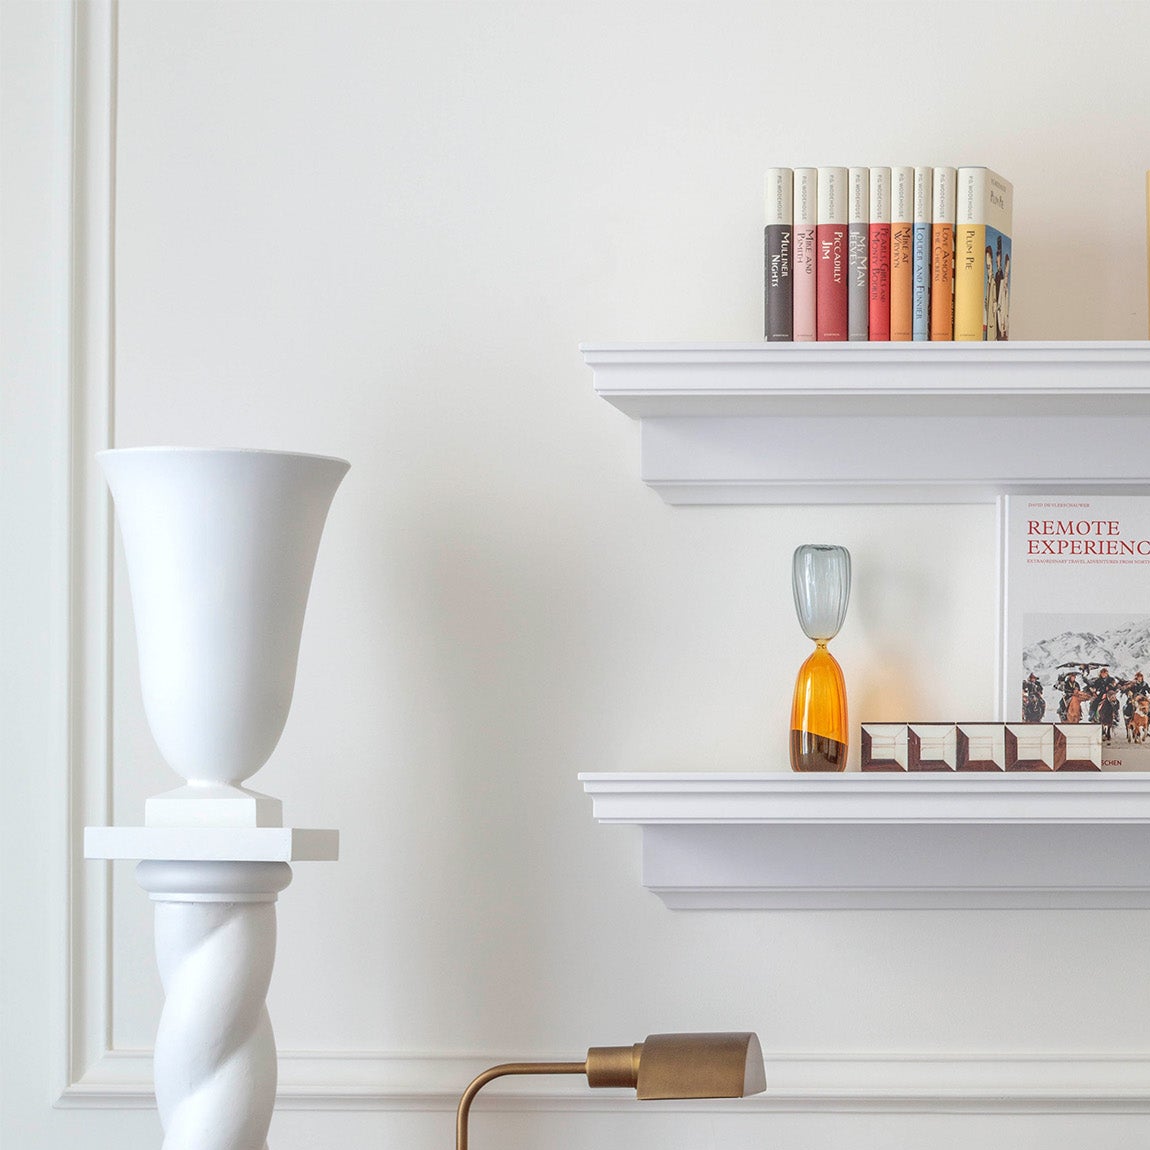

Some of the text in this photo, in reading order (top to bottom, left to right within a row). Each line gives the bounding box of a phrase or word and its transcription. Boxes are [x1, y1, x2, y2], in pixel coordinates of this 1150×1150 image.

[781, 232, 790, 277] MULLINER
[797, 233, 805, 263] PSMITH
[805, 230, 814, 252] MIKE
[822, 240, 833, 259] JIM
[834, 231, 843, 283] PICCADILLY
[849, 230, 859, 265] JEEVES
[872, 231, 880, 265] MONTY
[902, 227, 911, 263] MIKE AT
[942, 227, 950, 282] LOVE AMONG
[965, 230, 975, 270] PLUM PIE
[771, 254, 780, 287] NIGHTS
[856, 235, 867, 286] MY MAN
[916, 227, 926, 319] LOUDER AND FUNNIER
[1027, 520, 1120, 536] REMOTE
